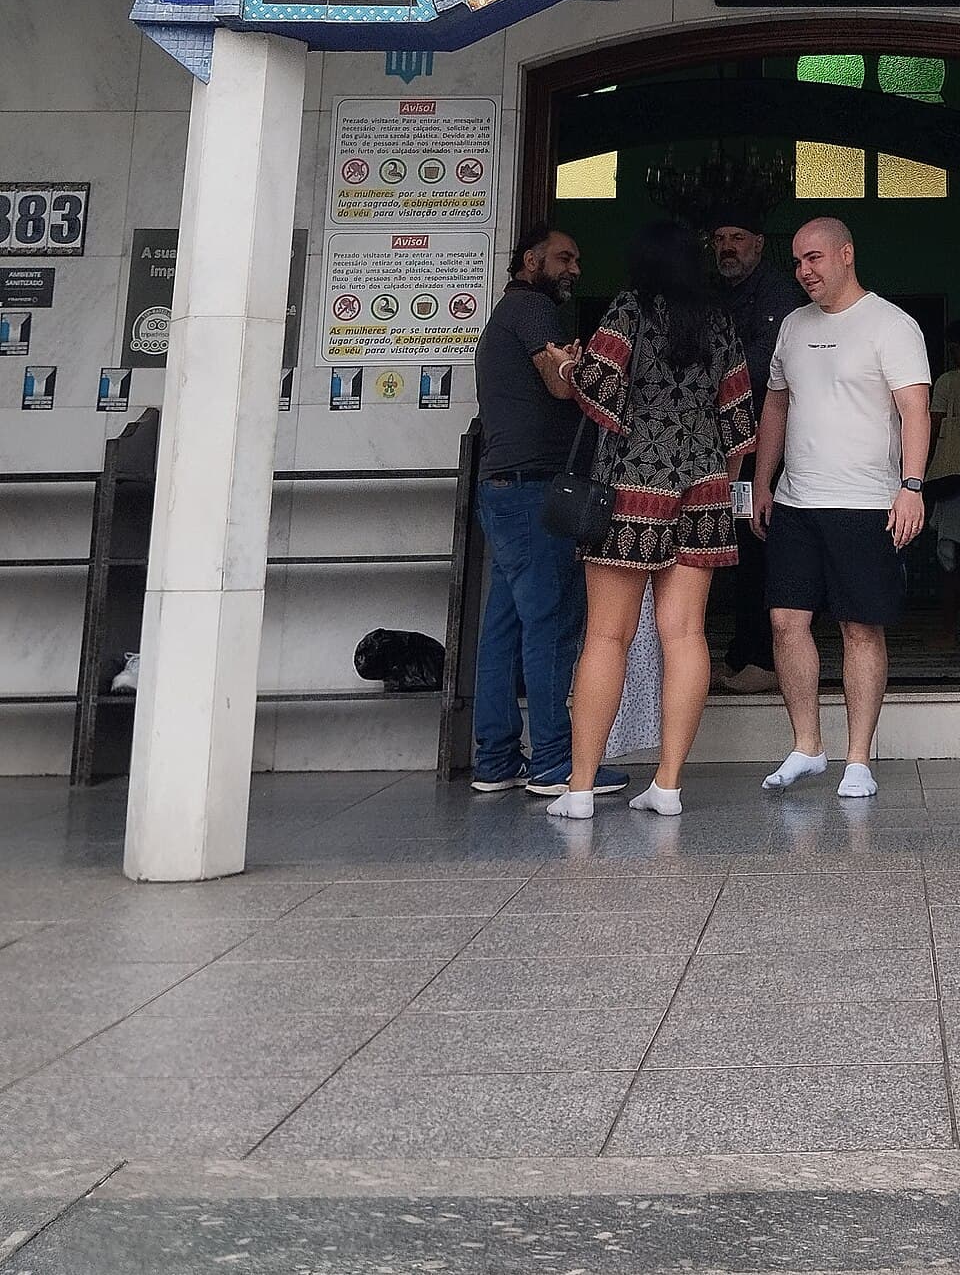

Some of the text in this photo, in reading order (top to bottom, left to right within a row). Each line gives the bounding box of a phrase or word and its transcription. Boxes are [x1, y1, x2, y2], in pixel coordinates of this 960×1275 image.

[402, 101, 434, 113] Aviso!
[393, 236, 428, 247] Aviso!
[141, 247, 152, 259] A
